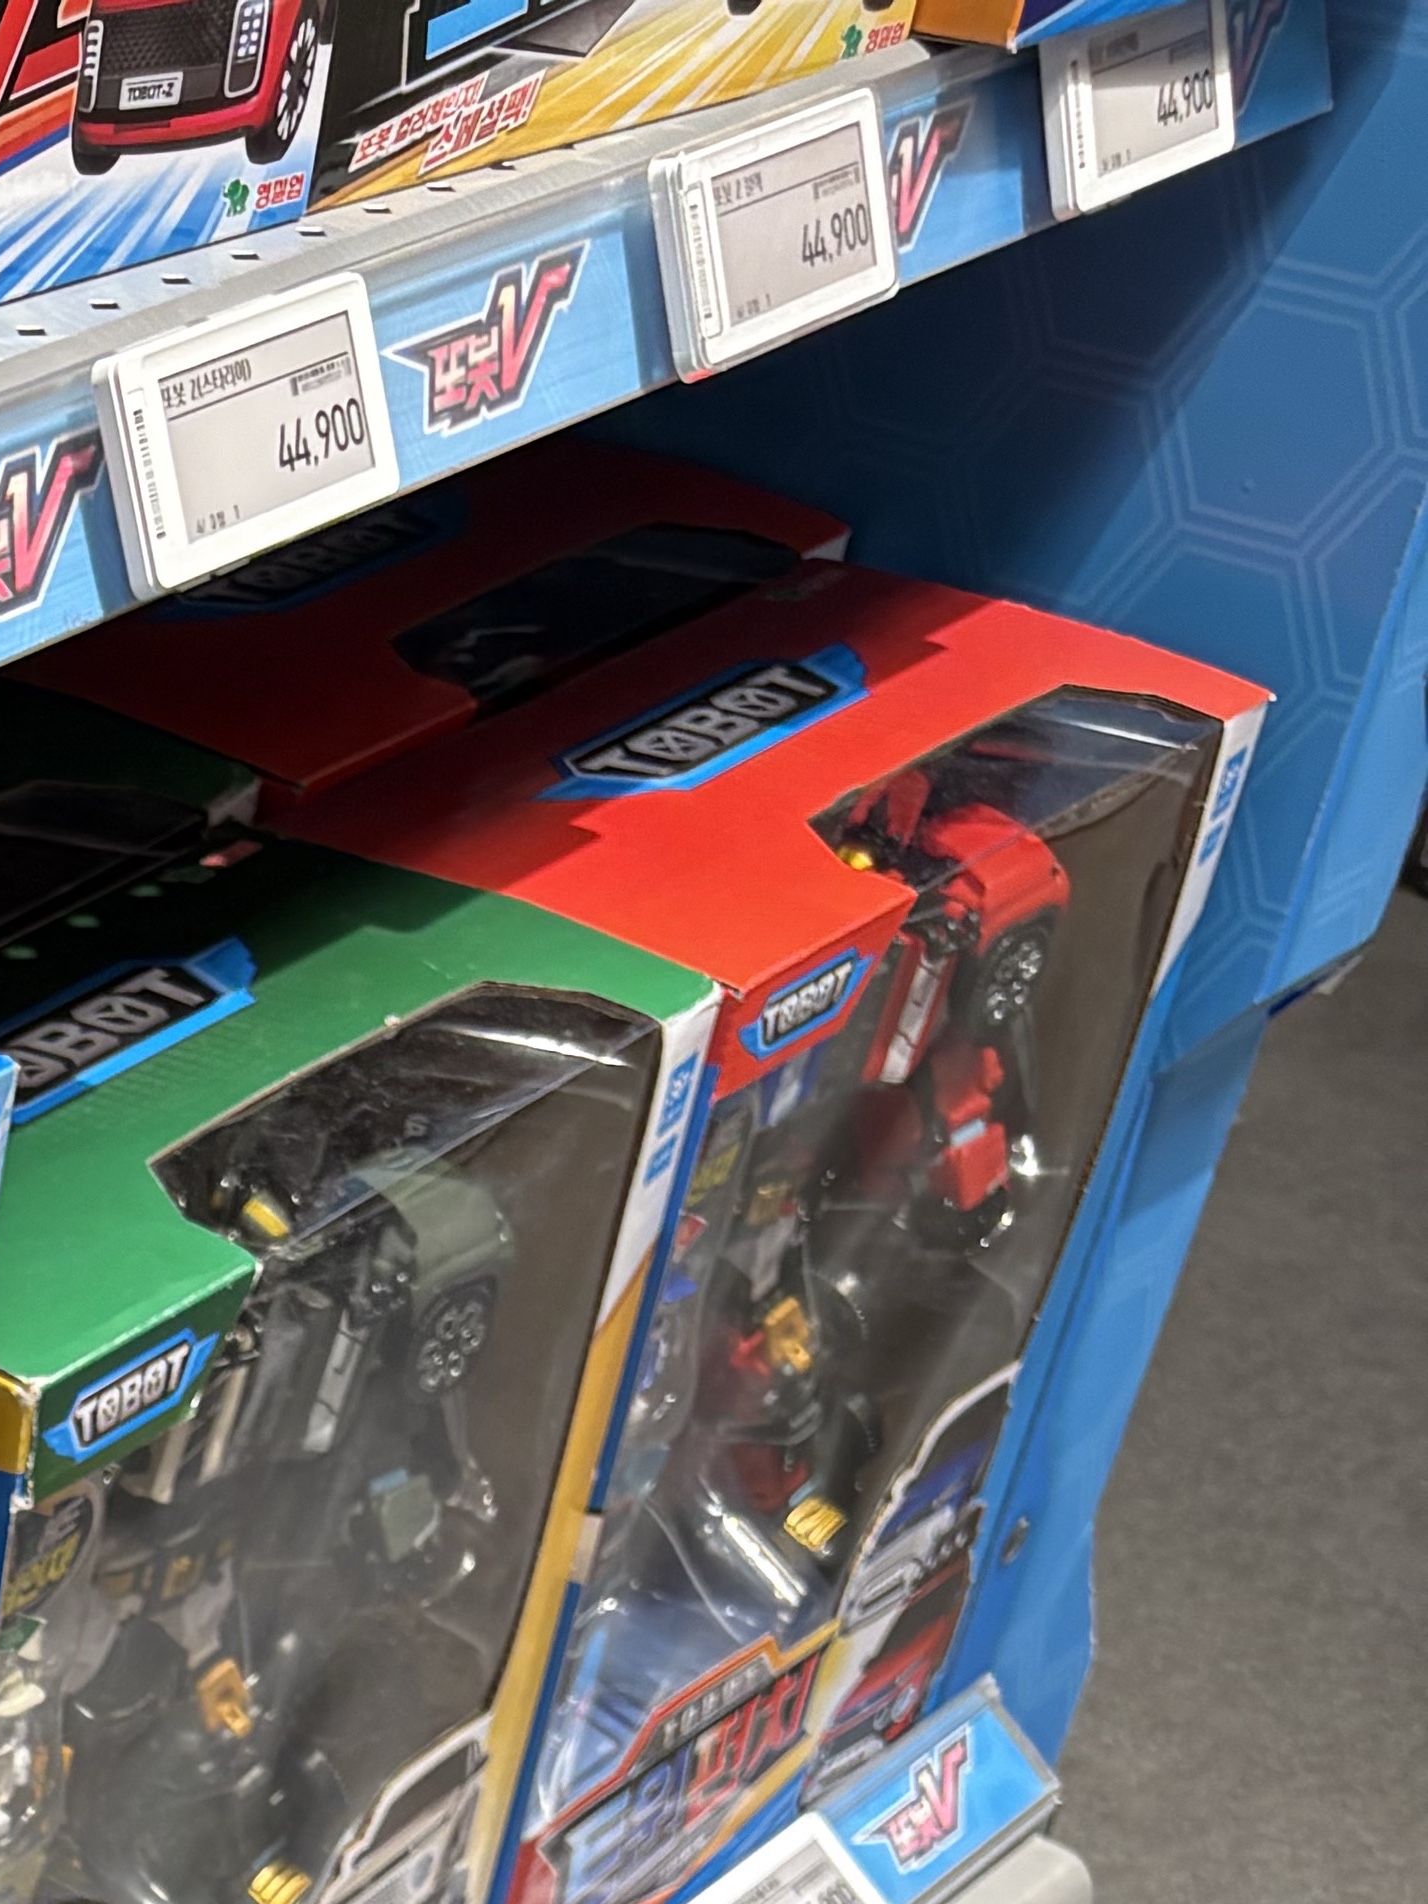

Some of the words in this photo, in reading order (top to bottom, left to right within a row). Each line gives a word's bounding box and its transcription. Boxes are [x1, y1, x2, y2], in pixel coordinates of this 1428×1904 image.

[127, 82, 175, 102] TOBOT-Z
[1157, 67, 1214, 127] 44,900
[256, 172, 305, 210] 영실업
[801, 203, 869, 268] 44,900
[278, 396, 365, 472] 44,900
[578, 664, 838, 784] TOBOT
[12, 964, 217, 1092] OBOT
[760, 952, 852, 1040] TOBOT
[71, 1350, 192, 1453] TOBOT
